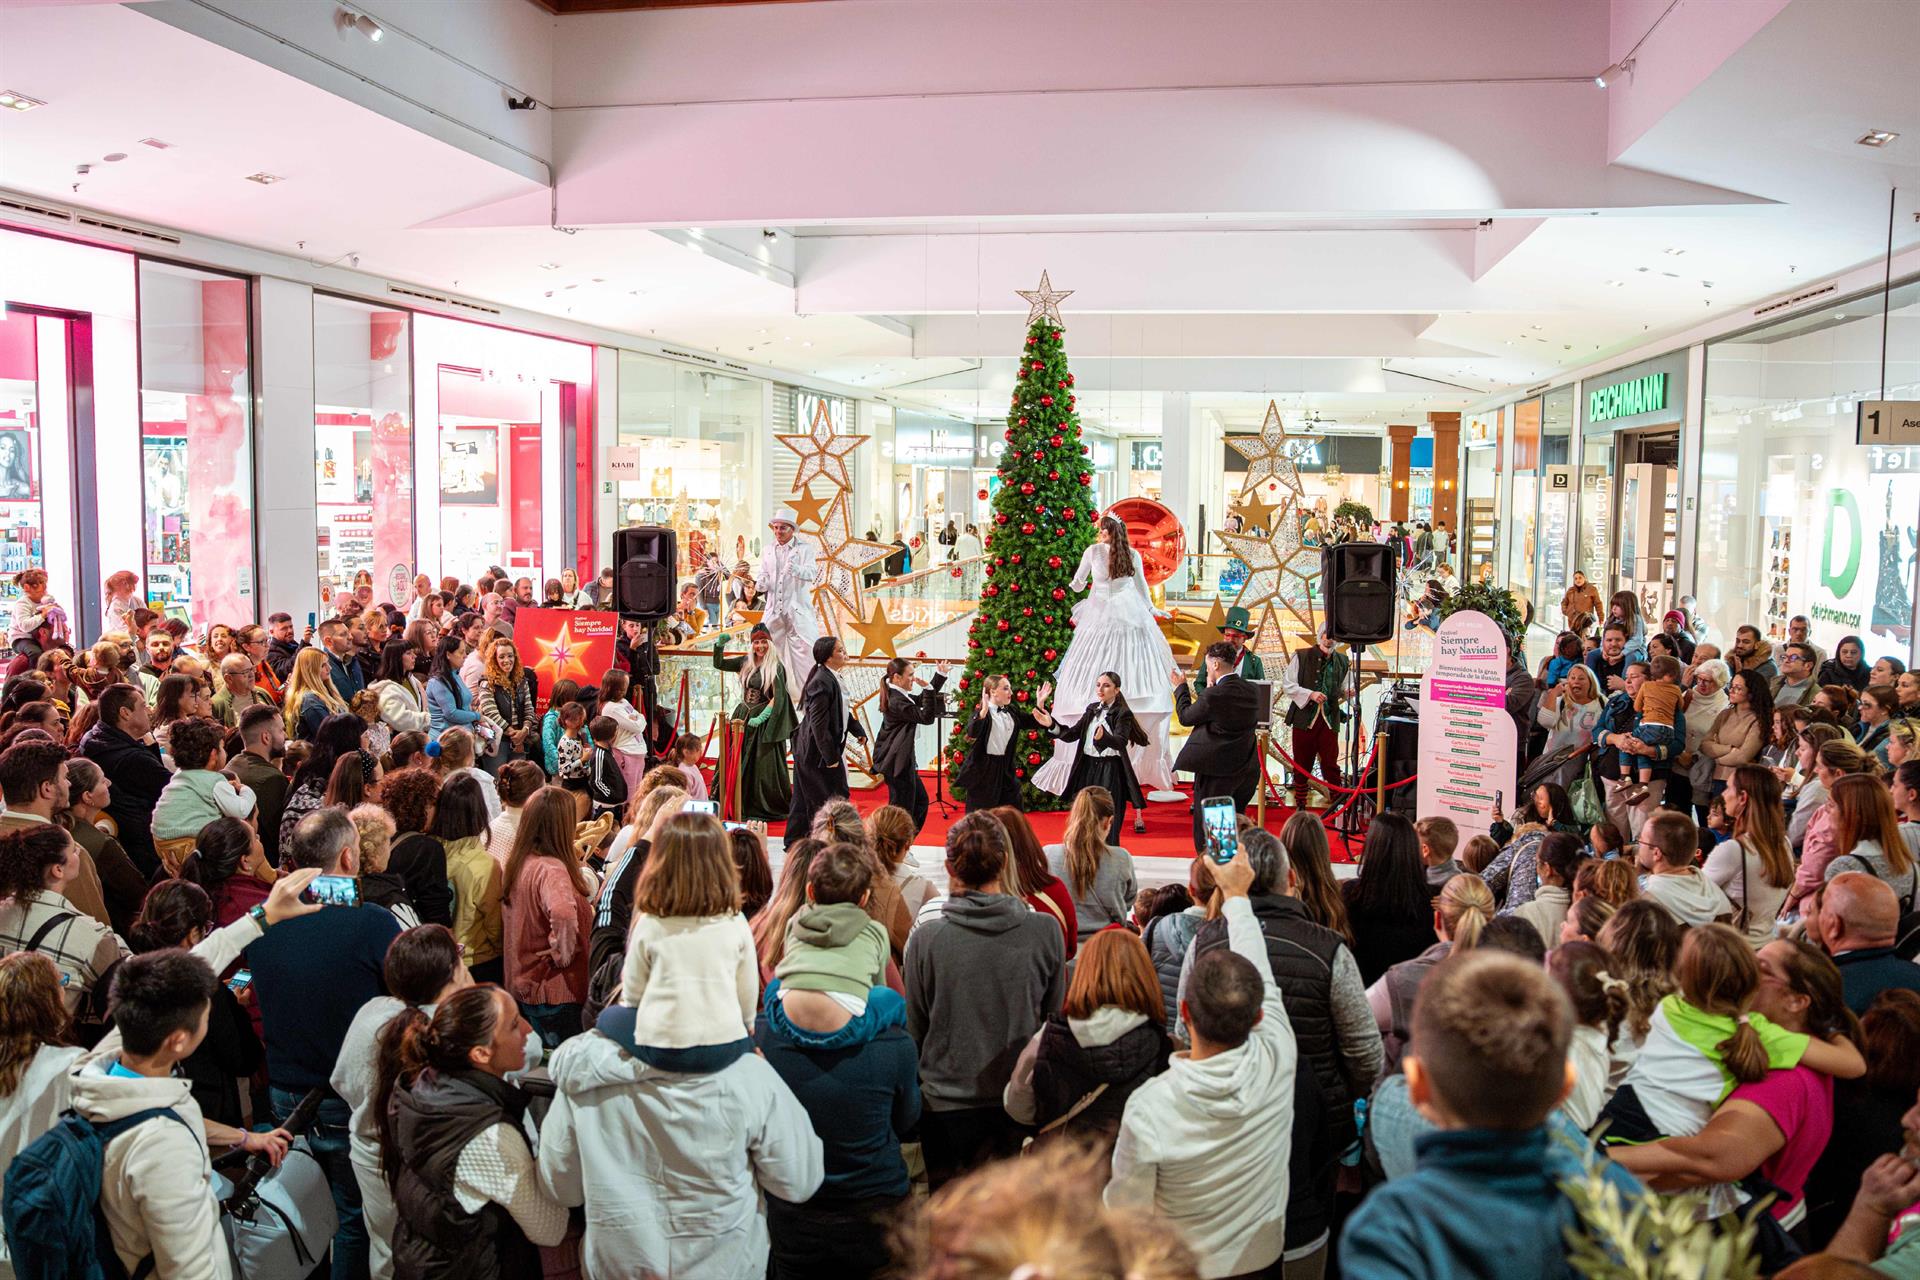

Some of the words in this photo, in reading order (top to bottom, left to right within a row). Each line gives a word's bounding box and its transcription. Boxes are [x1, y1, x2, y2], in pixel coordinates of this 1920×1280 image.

[1590, 372, 1664, 423] DEICHMANN
[1867, 410, 1880, 434] 1
[1589, 477, 1607, 592] eichmann.com
[1440, 636, 1479, 646] Siempre
[1441, 646, 1458, 656] hay
[1459, 645, 1497, 655] Navidad
[1439, 665, 1472, 673] Bienvenidos
[1436, 670, 1466, 678] temporada
[1480, 674, 1501, 682] ilusión
